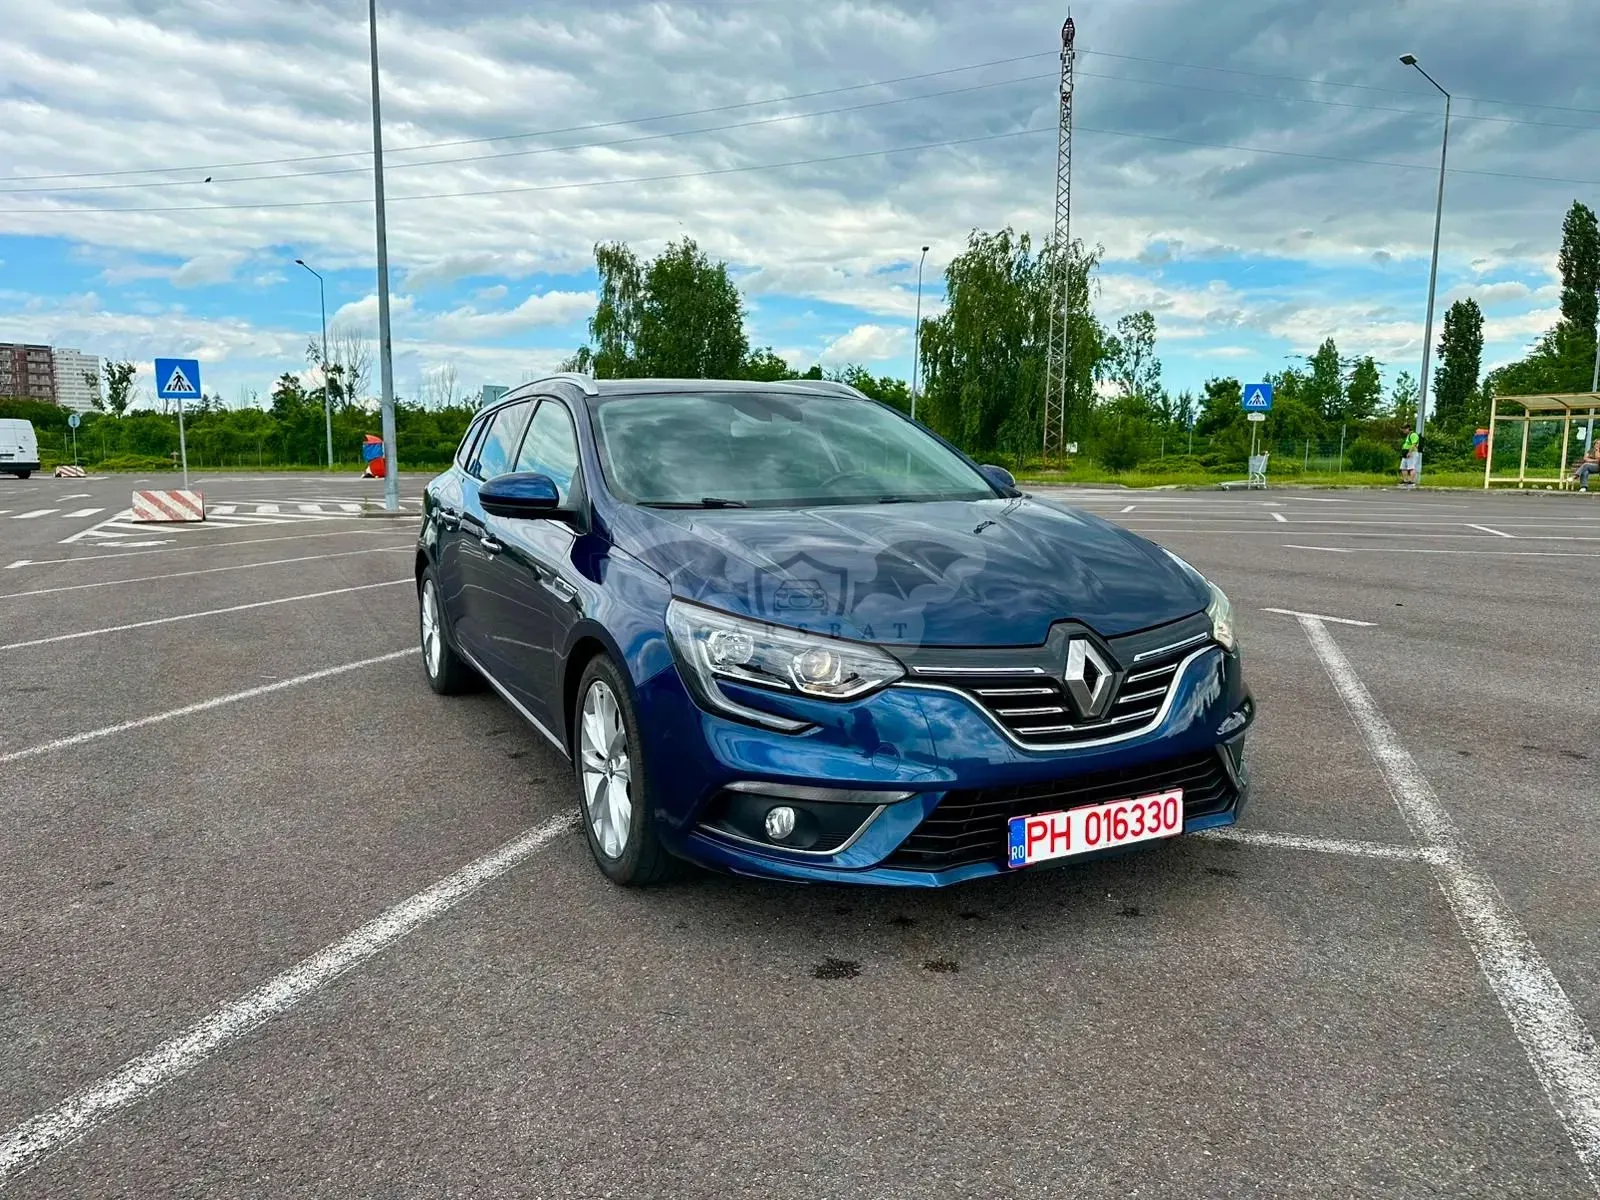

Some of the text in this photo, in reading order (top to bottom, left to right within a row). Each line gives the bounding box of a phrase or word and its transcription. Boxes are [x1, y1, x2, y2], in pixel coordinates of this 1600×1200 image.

[1027, 797, 1178, 857] PH 016330
[1011, 845, 1024, 860] RO
